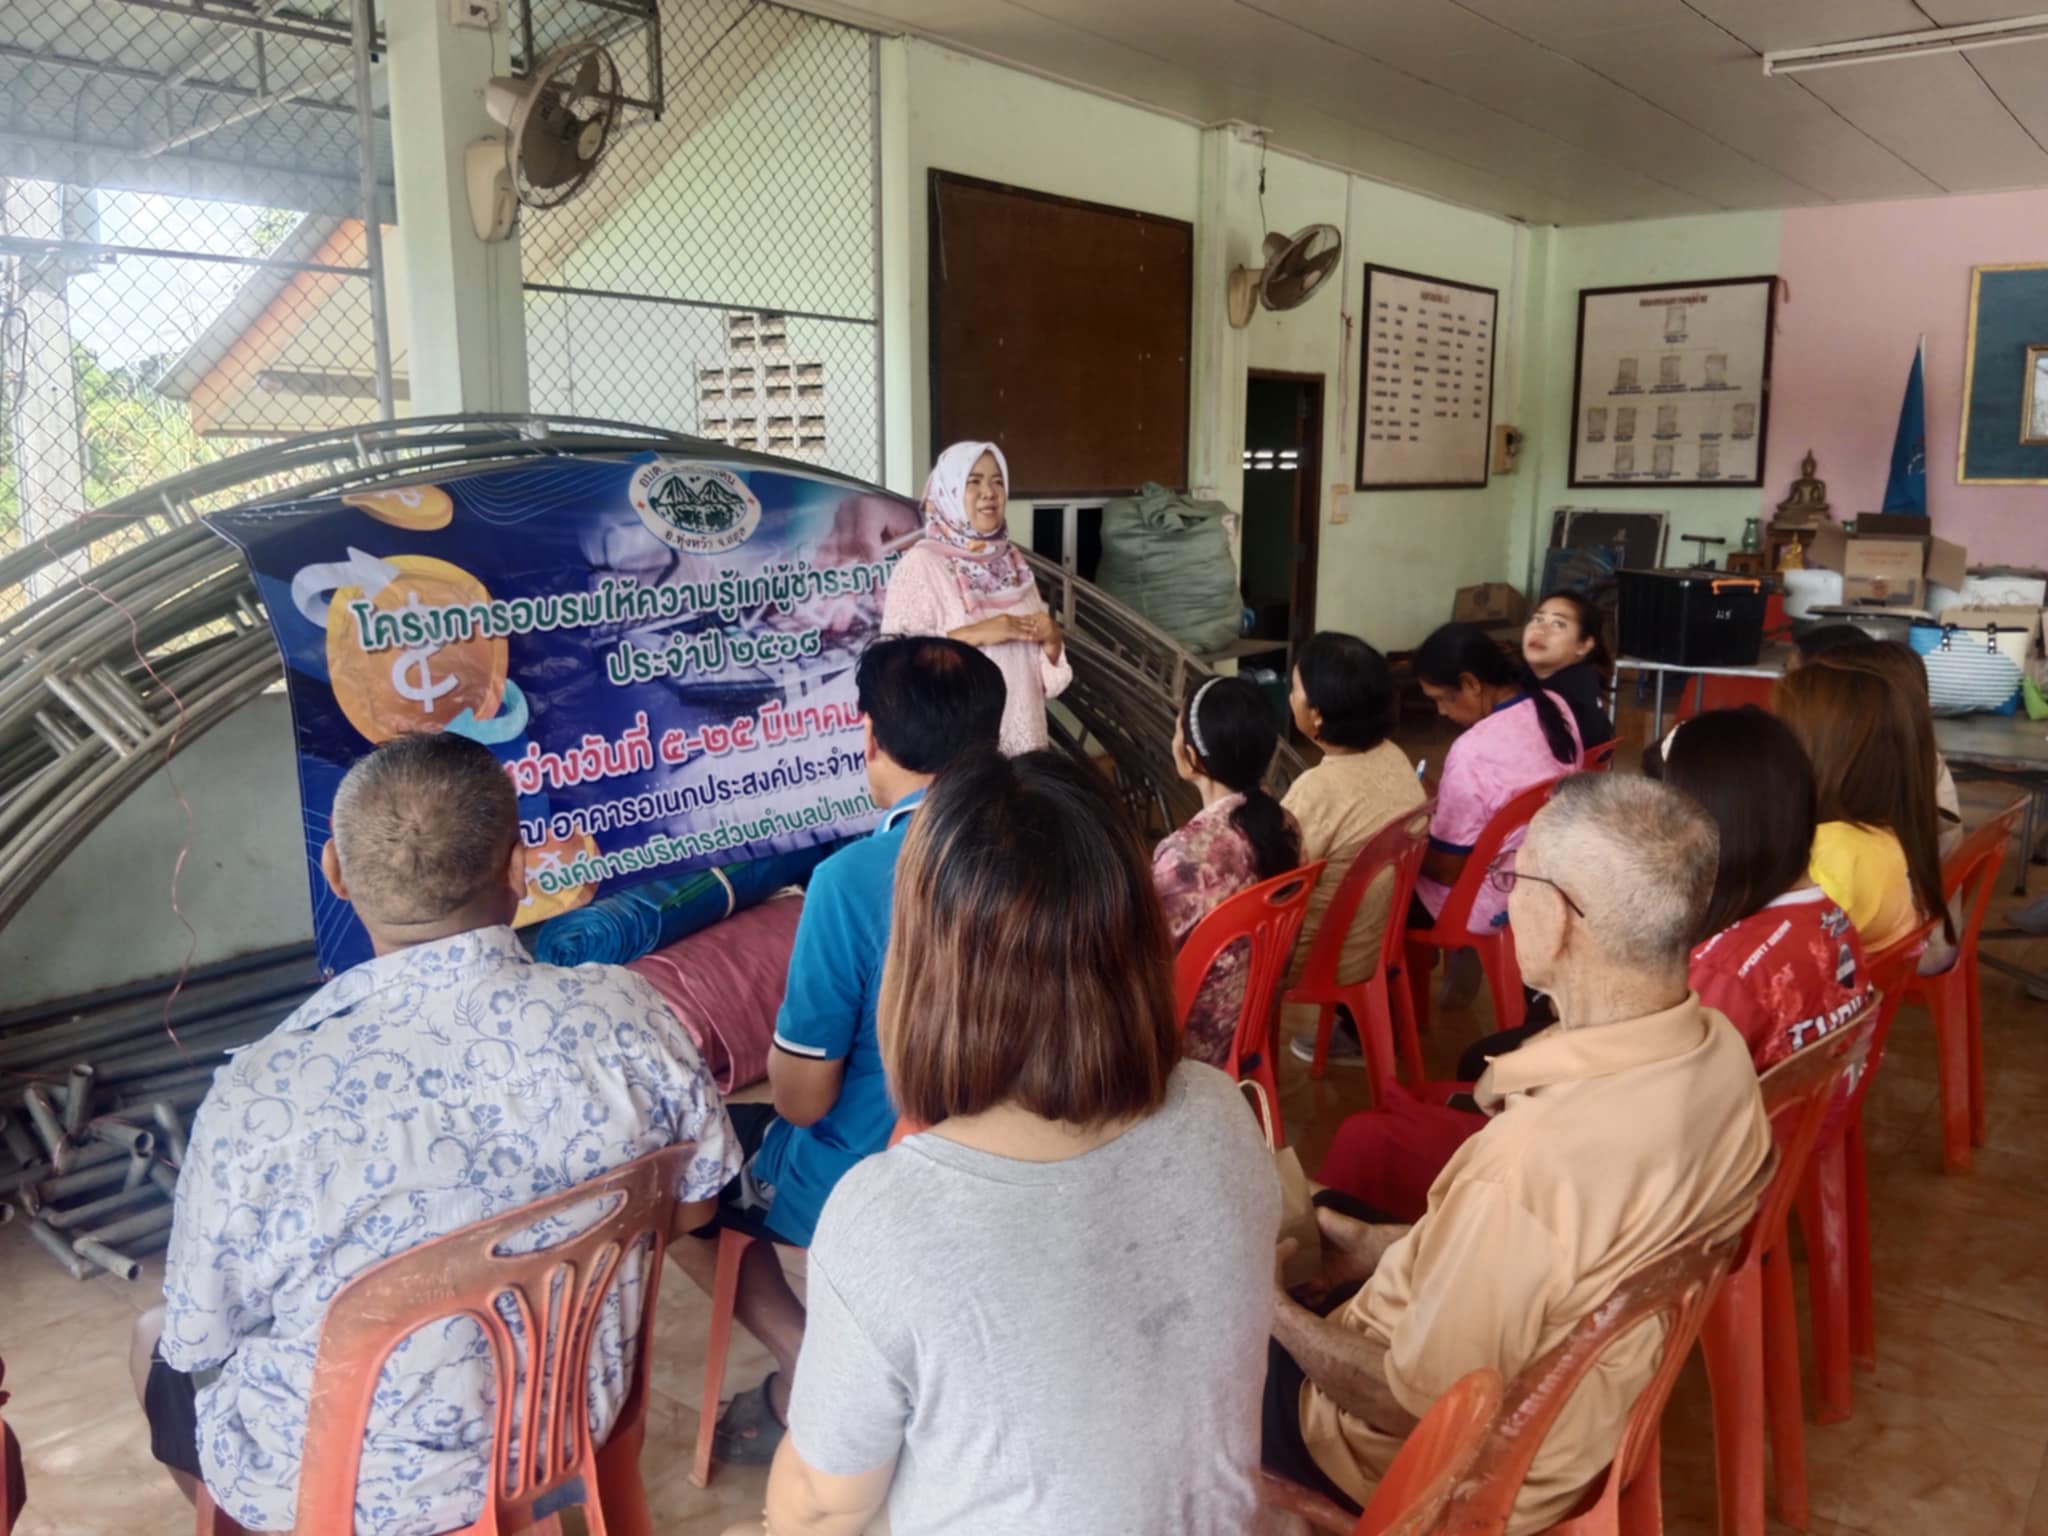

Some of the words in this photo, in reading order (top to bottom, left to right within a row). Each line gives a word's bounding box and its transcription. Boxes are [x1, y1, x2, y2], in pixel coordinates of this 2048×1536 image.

[351, 552, 898, 648] โครงการอบรมให้ความรู้แก่ผู้ชำระภาี
[609, 630, 722, 683] ประจำปี
[731, 630, 820, 663] ๒๕๖๘
[662, 717, 754, 763] ๕-๒๕
[761, 701, 864, 742] มีนาคม
